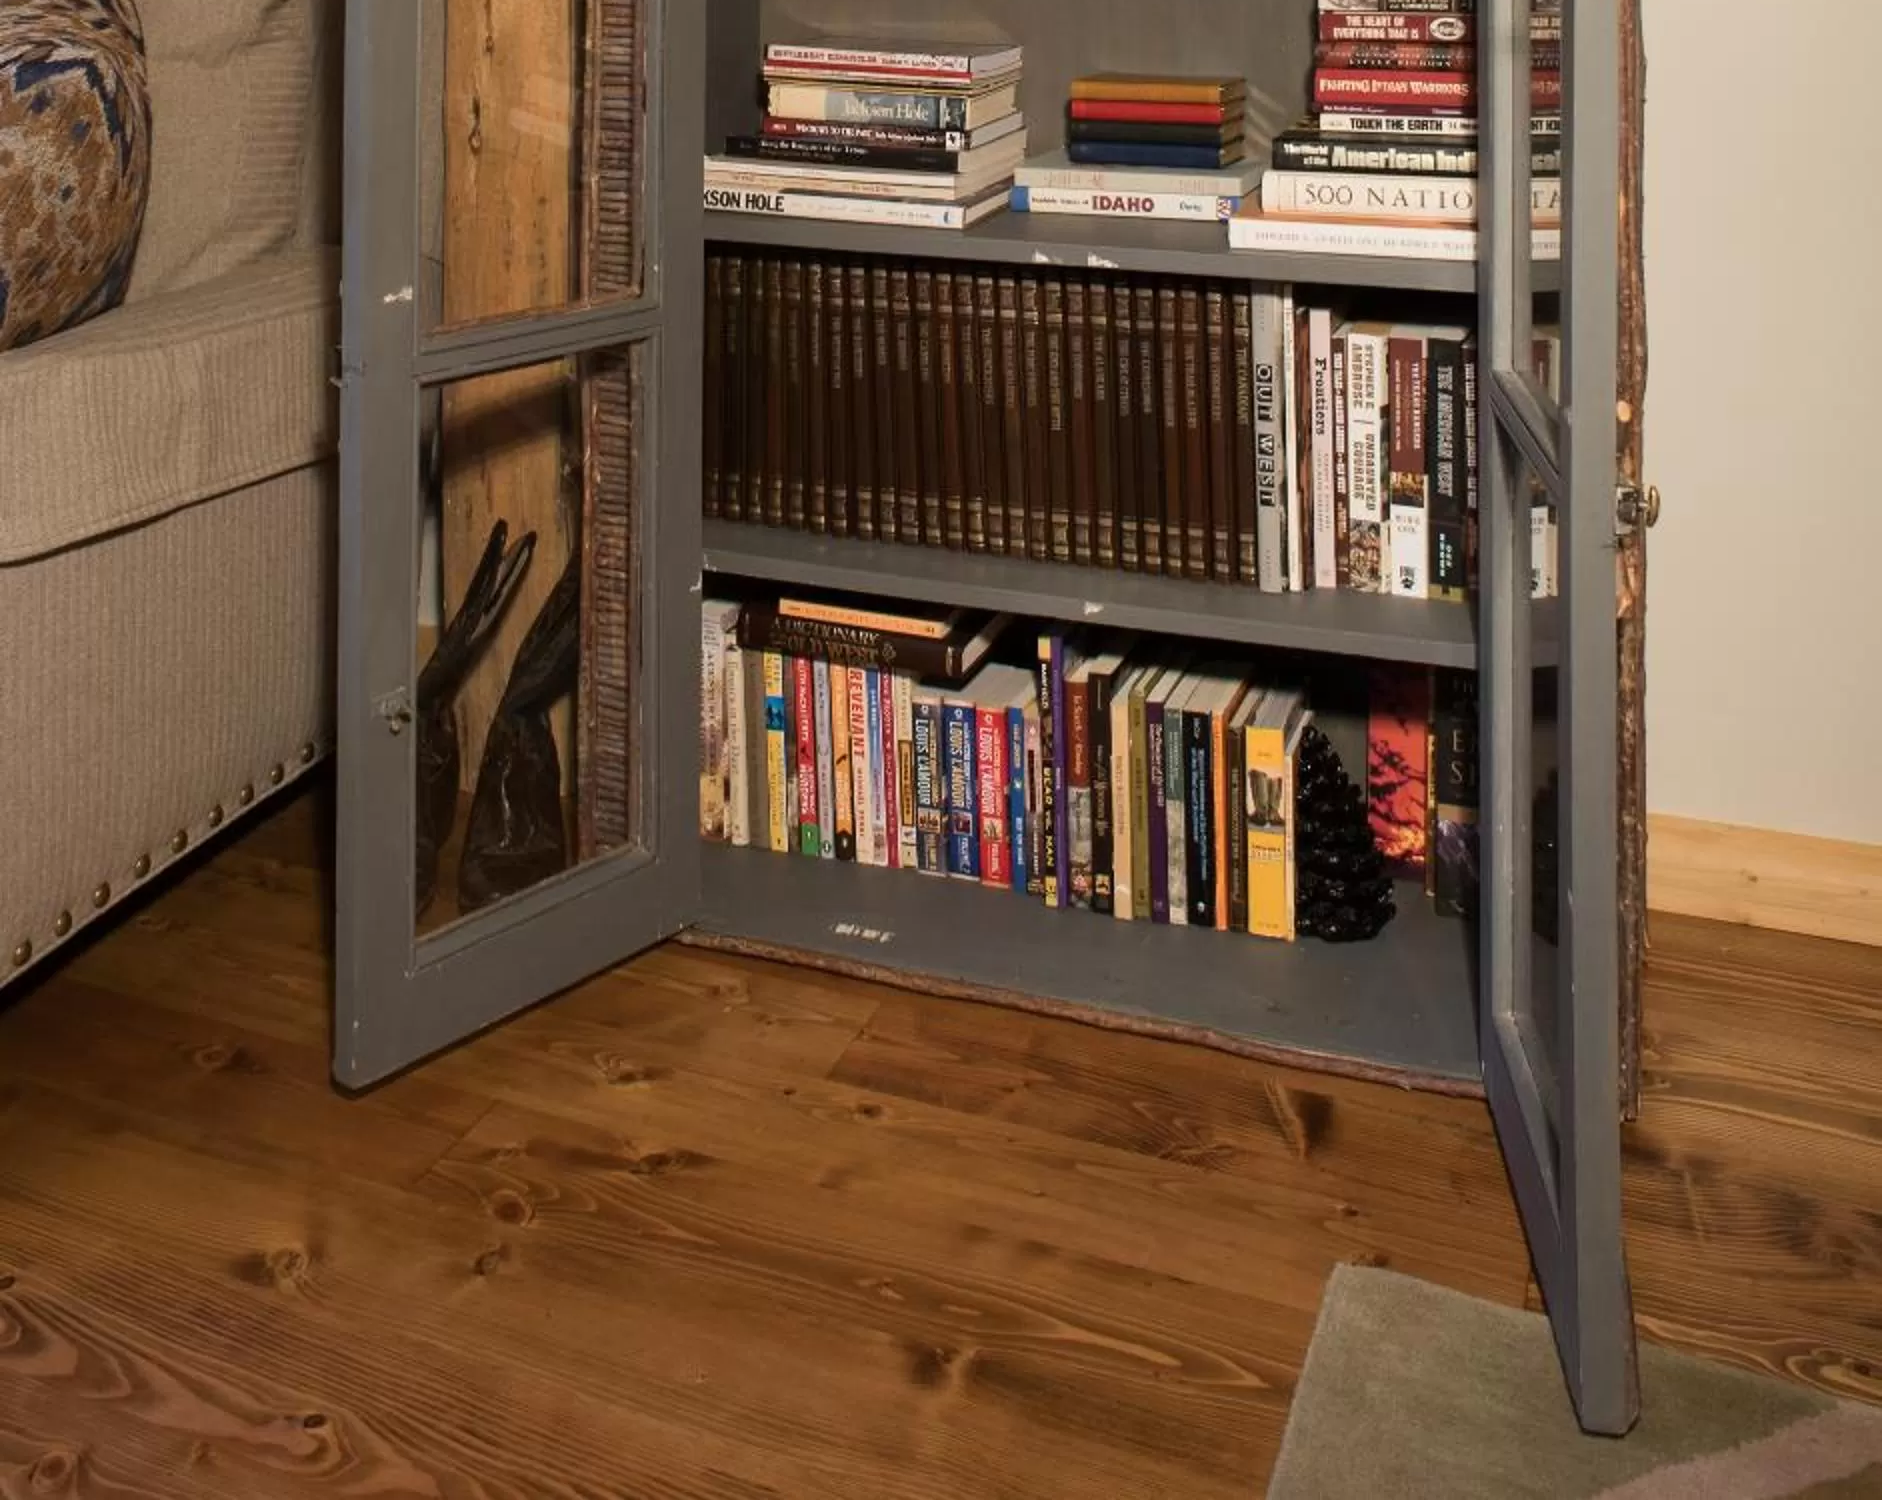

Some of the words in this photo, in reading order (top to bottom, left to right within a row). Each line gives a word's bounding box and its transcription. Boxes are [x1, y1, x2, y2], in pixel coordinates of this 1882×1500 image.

[1346, 16, 1362, 26] THE
[1394, 16, 1405, 26] OF
[896, 102, 929, 121] Hole
[1350, 117, 1383, 131] TOUCH
[1385, 118, 1405, 131] THE
[1408, 119, 1443, 132] EARTH
[1331, 146, 1434, 170] American
[746, 193, 784, 212] HOLE
[1092, 195, 1155, 213] IDAHO
[1352, 344, 1363, 409] AMBROSE
[1365, 344, 1375, 398] STEPHEN
[1437, 365, 1453, 389] THE
[1256, 364, 1273, 421] OUT
[1315, 357, 1327, 436] Frontiers
[1437, 392, 1453, 458] AMERICAN
[1258, 433, 1275, 508] WEST
[1353, 441, 1364, 500] COURAGE
[1366, 433, 1376, 510] UNDAUNTED
[1437, 461, 1453, 497] WEST
[785, 619, 880, 644] DICTIONARY
[849, 670, 864, 758] REVENANT
[915, 719, 929, 753] LOUIS
[949, 722, 963, 755] LOUIS
[979, 727, 993, 762] LOUIS
[917, 756, 930, 805] L'AMOUR
[952, 759, 966, 807] L'AMOUR
[981, 765, 995, 814] L'AMOUR
[1045, 835, 1055, 867] MAN
